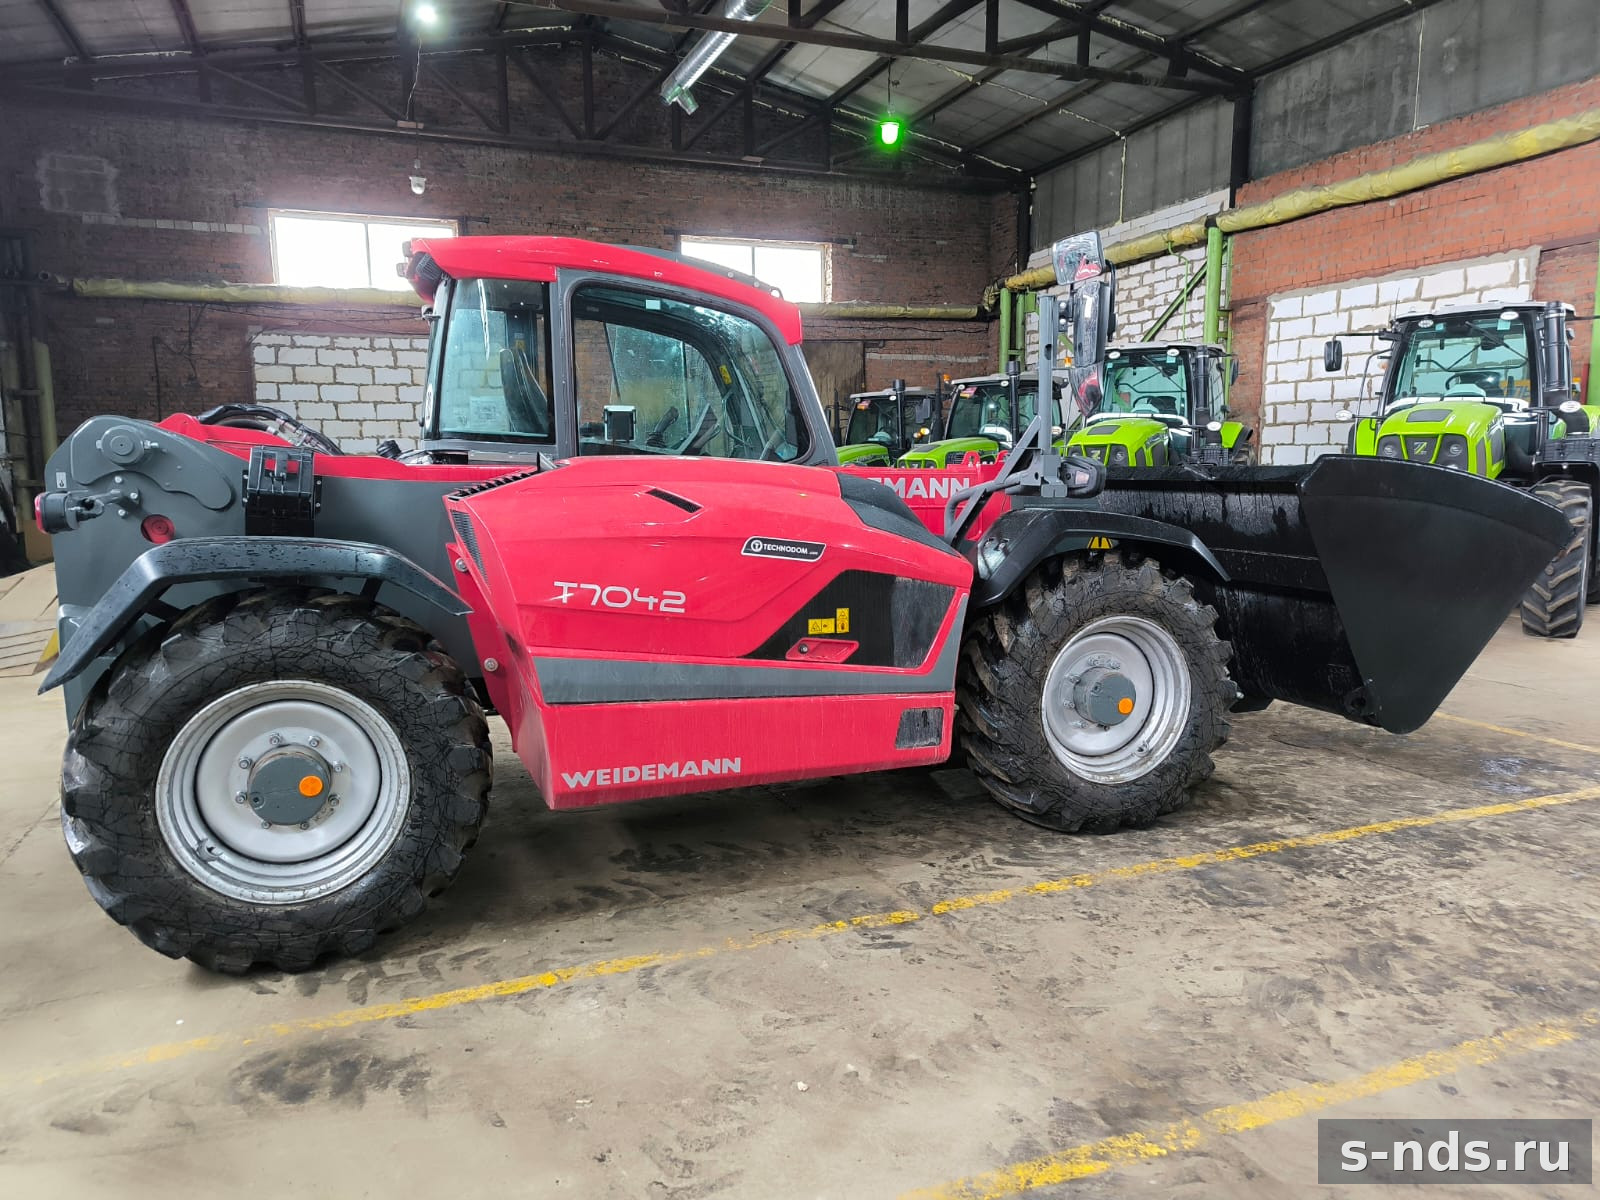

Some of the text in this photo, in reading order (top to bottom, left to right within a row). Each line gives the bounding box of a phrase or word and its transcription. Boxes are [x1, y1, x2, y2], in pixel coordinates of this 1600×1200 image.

[868, 477, 970, 499] MANN
[763, 543, 808, 555] TECHNODOM
[553, 581, 687, 614] T7042
[560, 757, 742, 789] WEIDEMANN
